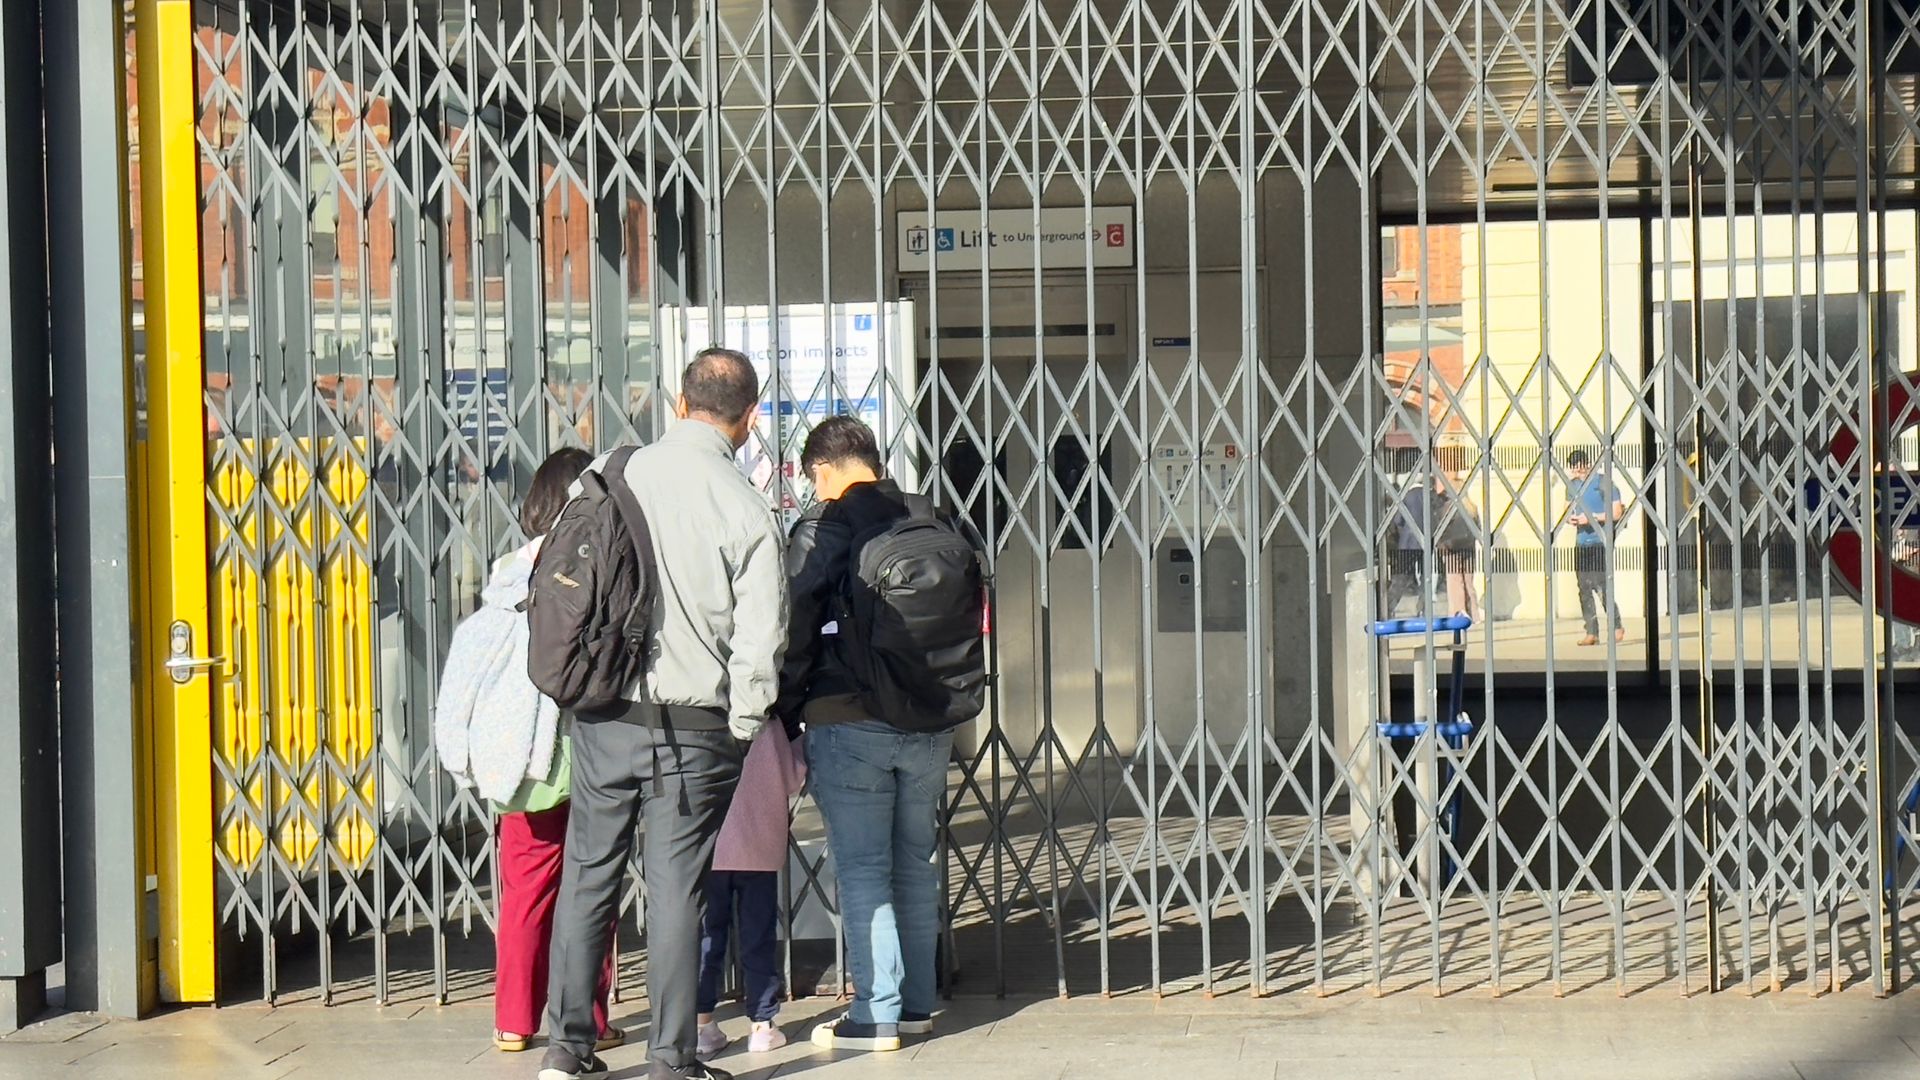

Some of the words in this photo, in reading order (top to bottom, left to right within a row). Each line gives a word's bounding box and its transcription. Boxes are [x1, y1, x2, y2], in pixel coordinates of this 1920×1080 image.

[1003, 234, 1015, 242] to
[1018, 231, 1086, 244] Unerground
[804, 341, 868, 358] imacts
